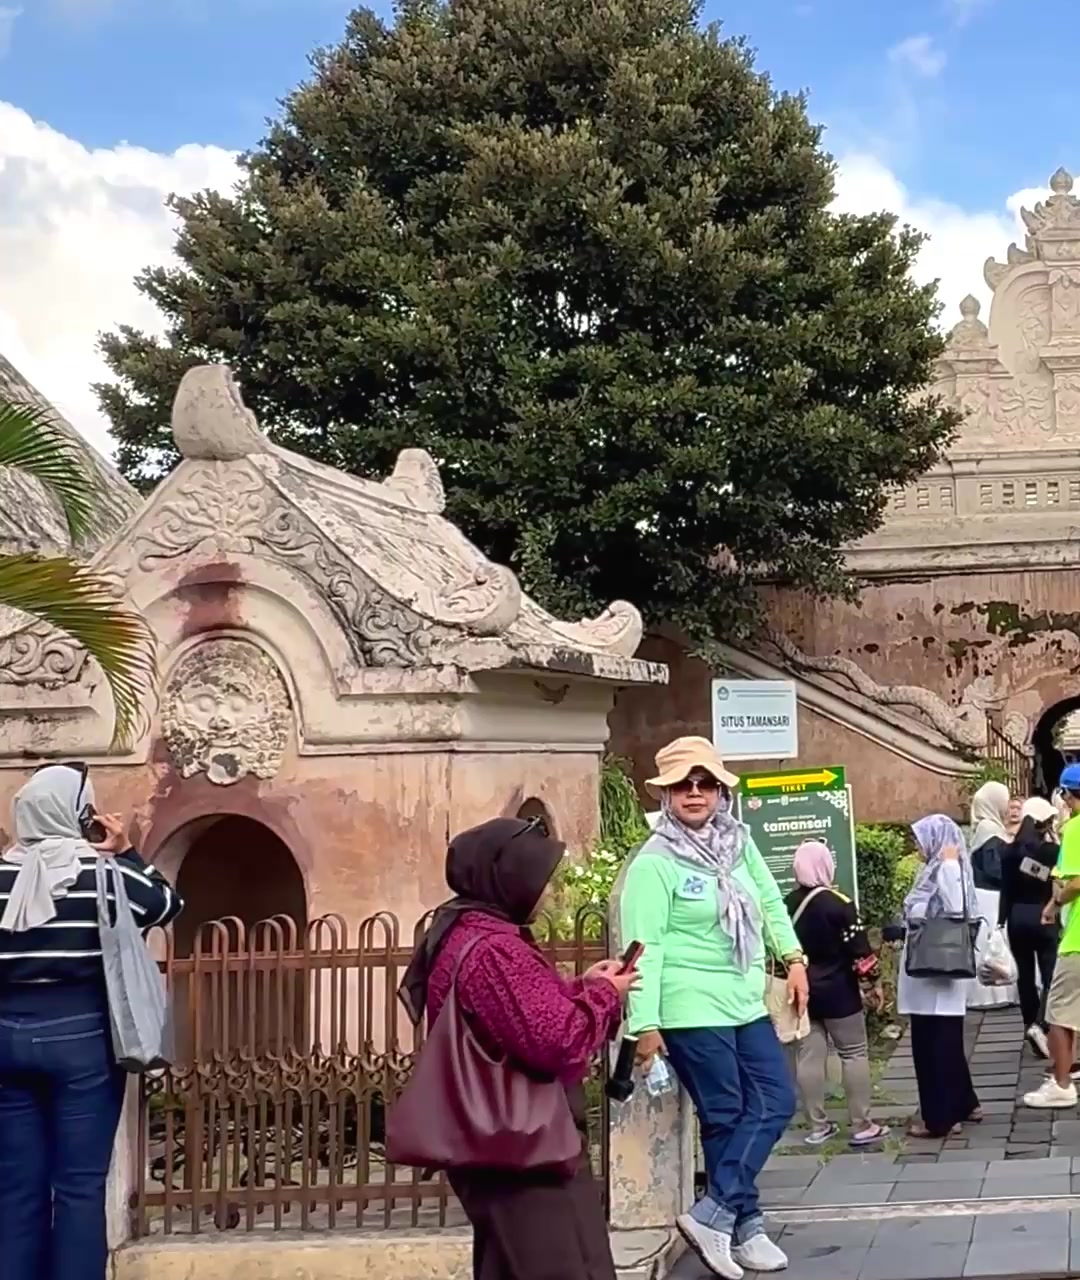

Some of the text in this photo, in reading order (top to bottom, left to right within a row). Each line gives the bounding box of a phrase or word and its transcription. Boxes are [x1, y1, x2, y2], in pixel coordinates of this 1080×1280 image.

[721, 715, 790, 727] SITUS TAMANSARI
[781, 783, 807, 793] TIKET
[763, 816, 832, 832] tamansari
